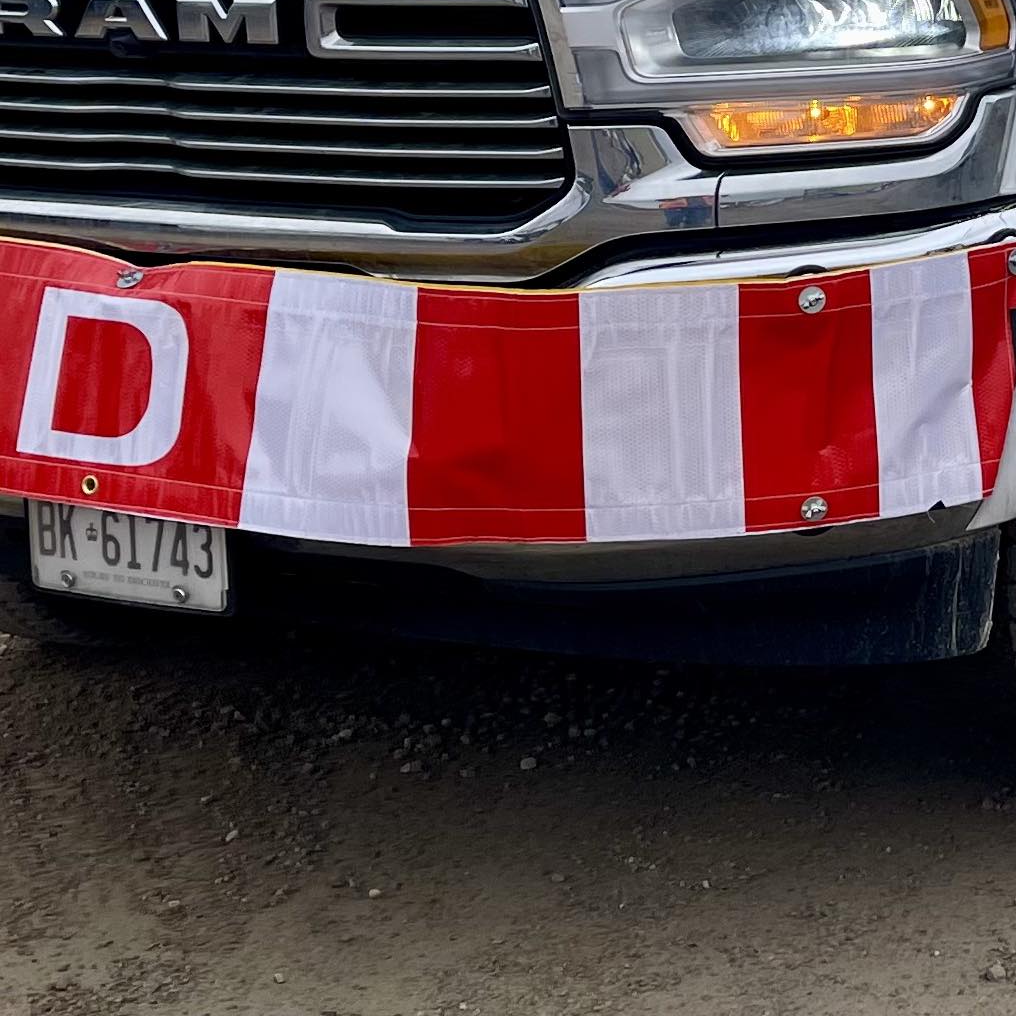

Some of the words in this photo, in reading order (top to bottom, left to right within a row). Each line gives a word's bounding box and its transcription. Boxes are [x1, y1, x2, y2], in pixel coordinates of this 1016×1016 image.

[16, 286, 189, 467] D
[38, 500, 78, 561] BK
[101, 511, 214, 579] 61743
